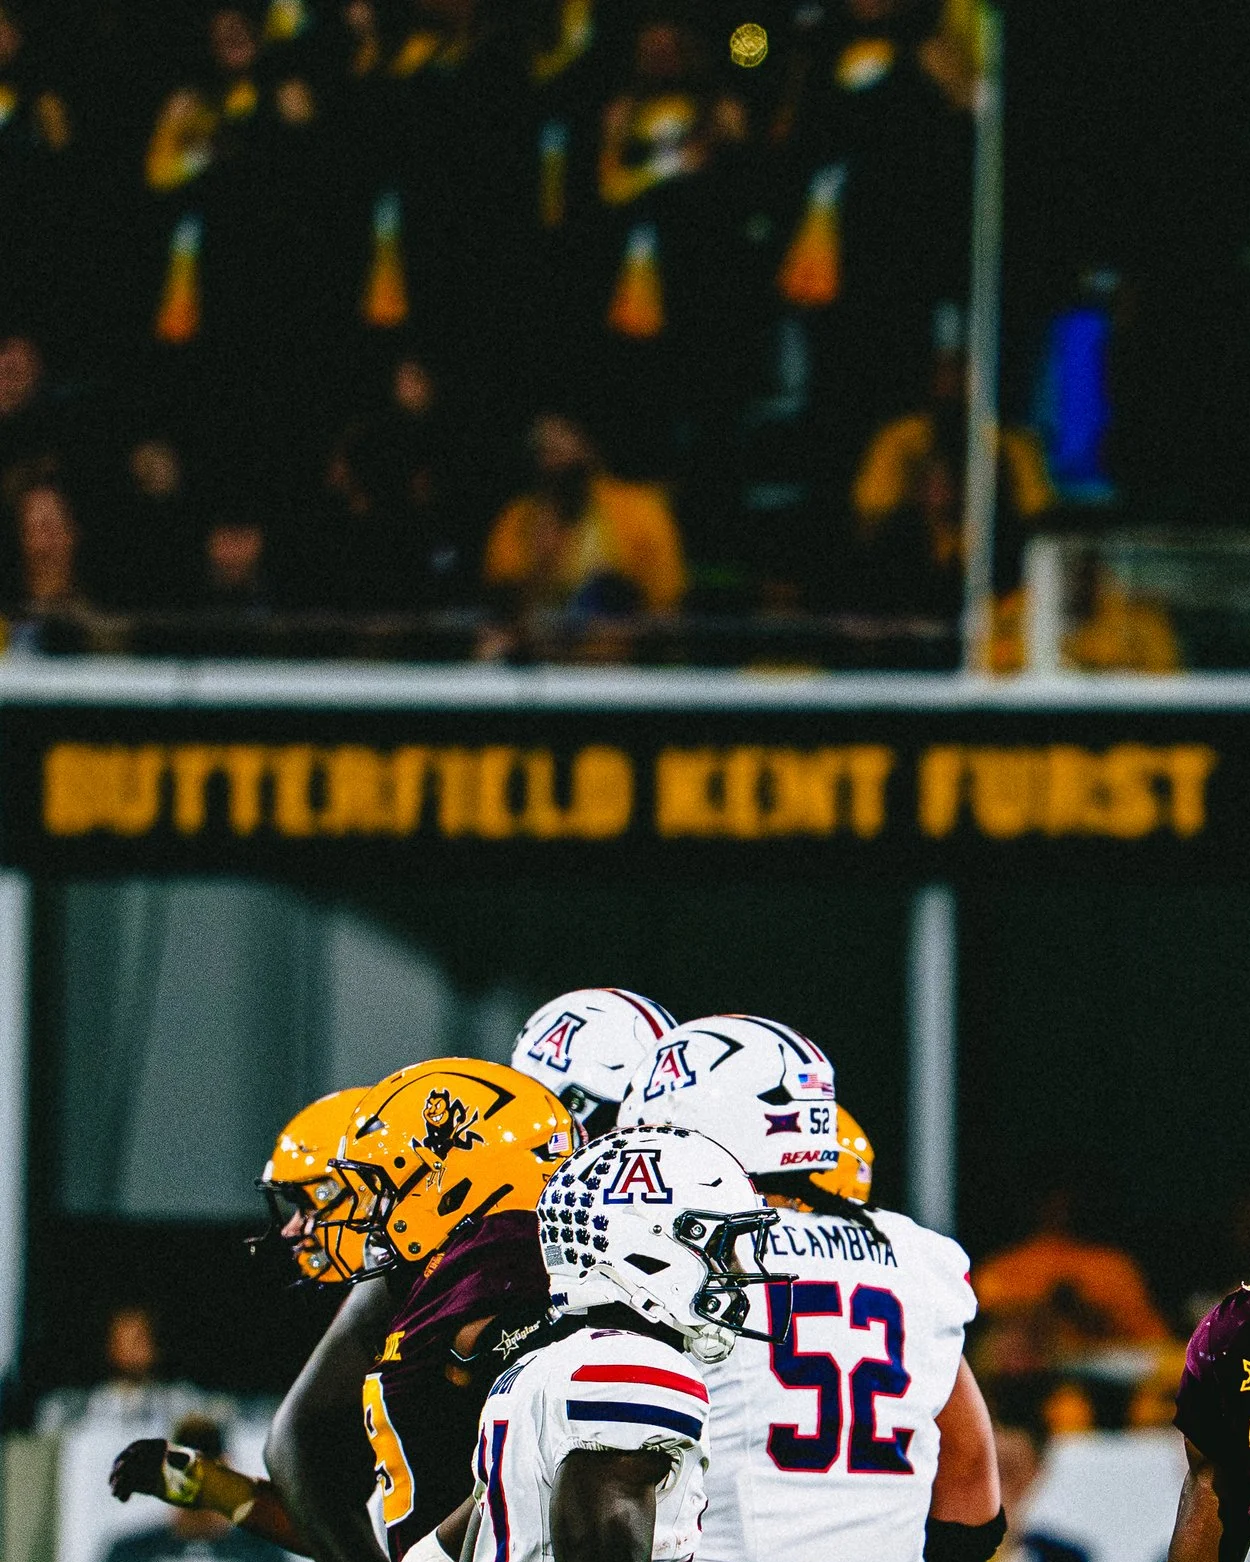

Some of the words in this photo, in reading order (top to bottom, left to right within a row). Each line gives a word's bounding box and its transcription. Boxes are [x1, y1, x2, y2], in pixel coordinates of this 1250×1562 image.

[654, 743, 895, 839] KENT
[917, 742, 1216, 839] FURST
[527, 1011, 588, 1073] A
[644, 1040, 697, 1102] A
[809, 1107, 830, 1134] 52
[603, 1149, 673, 1205] A
[765, 1281, 915, 1474] 52
